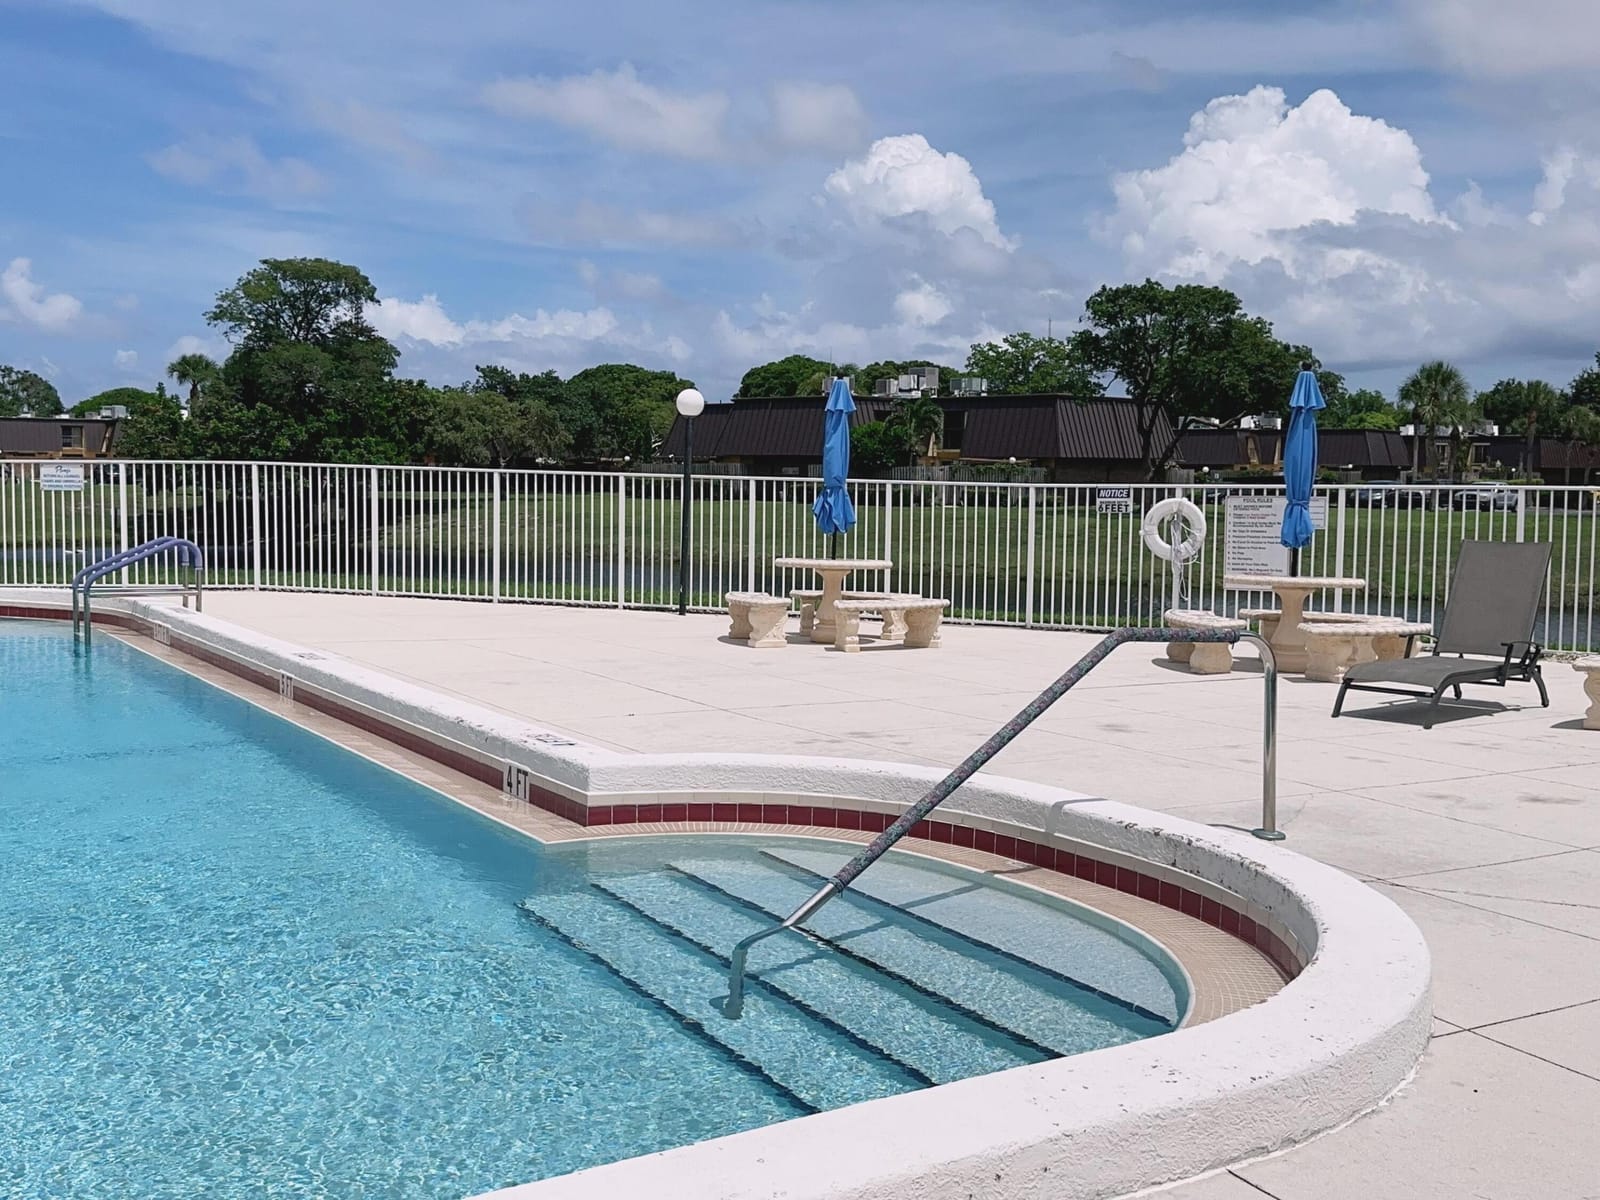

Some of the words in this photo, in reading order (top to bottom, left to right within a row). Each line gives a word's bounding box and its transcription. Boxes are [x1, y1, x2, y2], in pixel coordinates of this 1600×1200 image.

[1099, 489, 1129, 498] NOTICE
[1105, 503, 1130, 512] FEET
[506, 765, 513, 794] 4
[516, 768, 529, 799] FT
